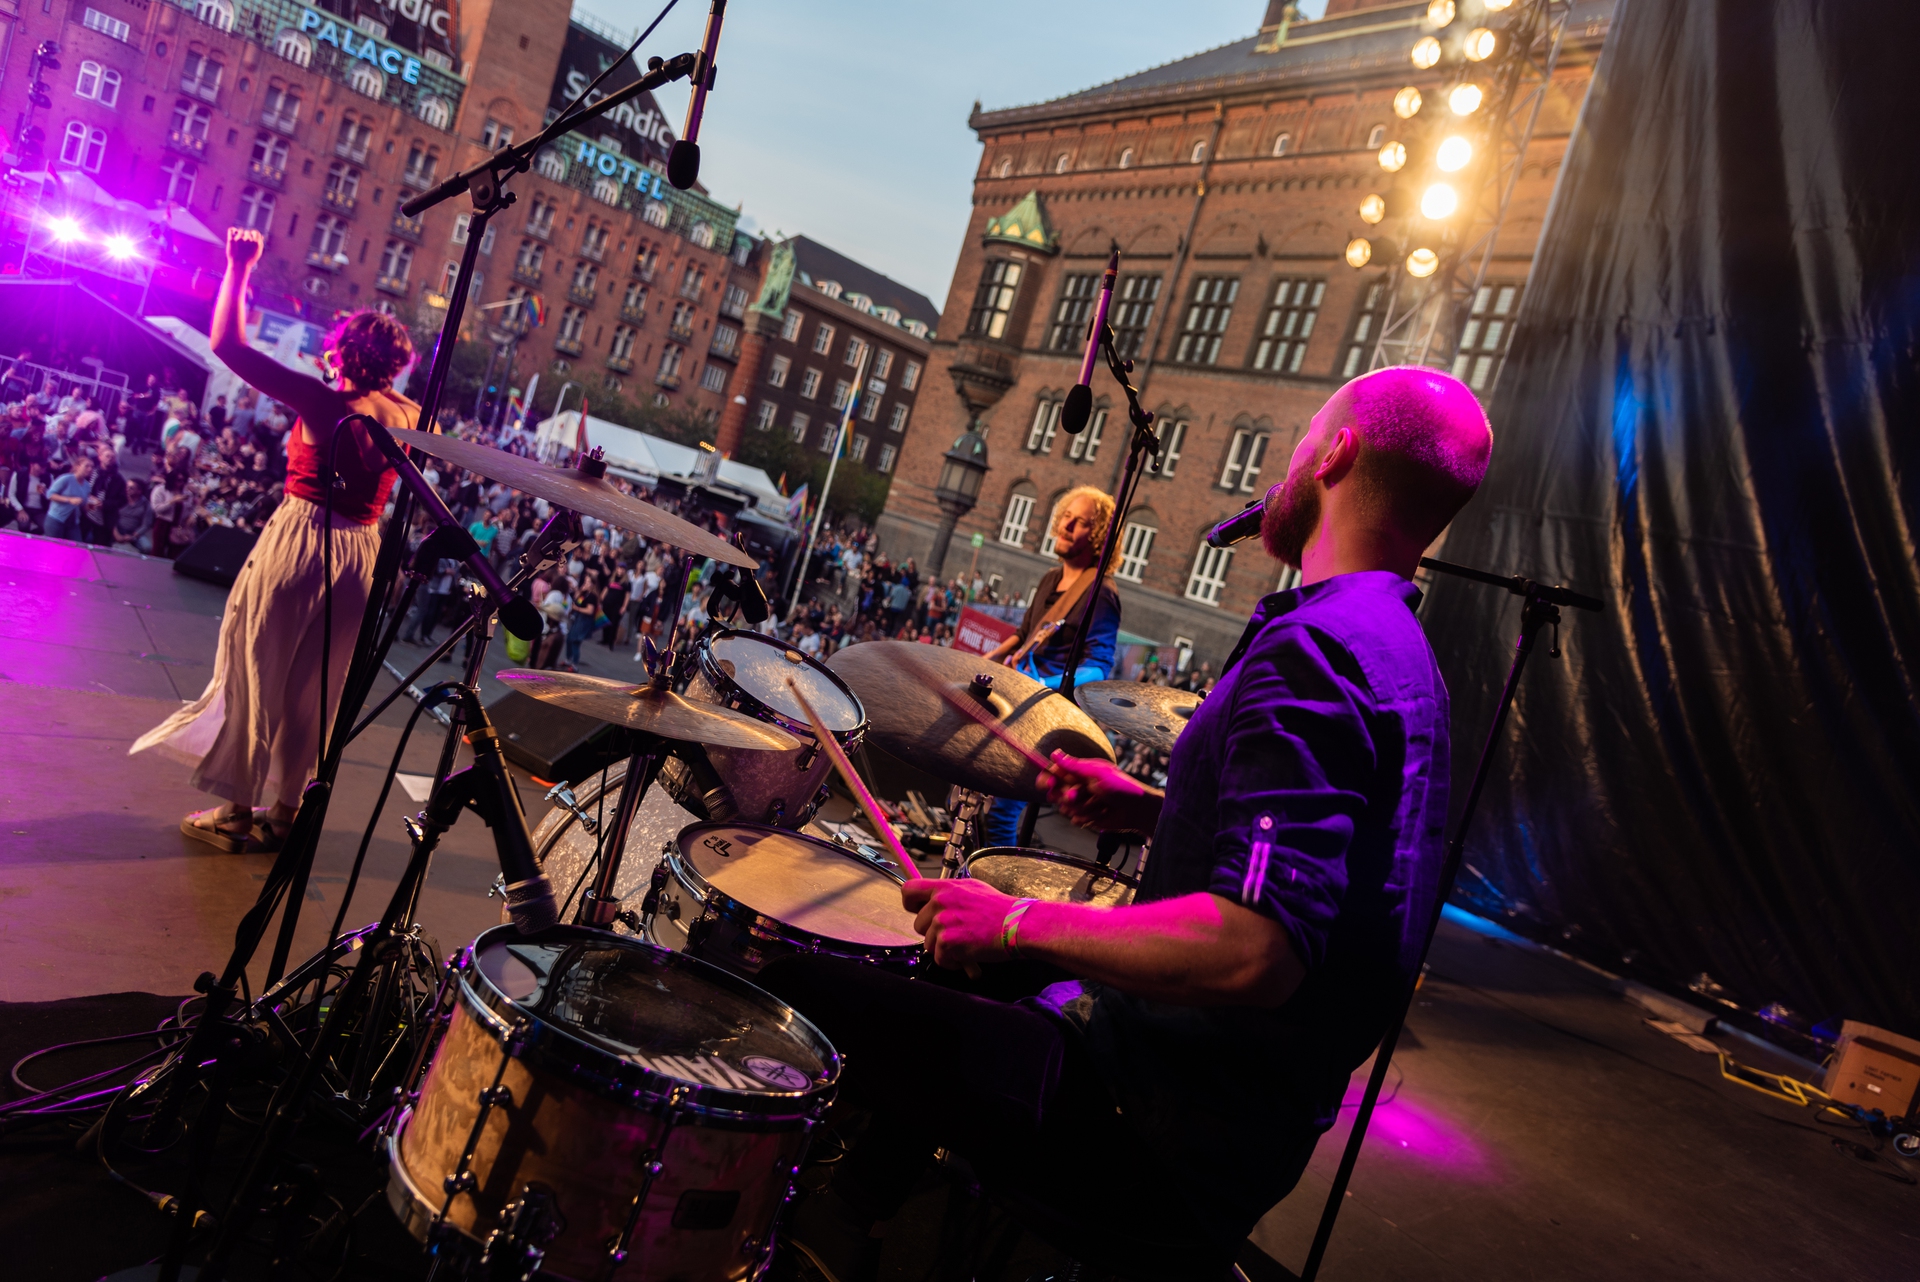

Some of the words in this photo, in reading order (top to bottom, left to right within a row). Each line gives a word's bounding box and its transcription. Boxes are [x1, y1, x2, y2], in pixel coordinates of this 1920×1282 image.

[301, 7, 421, 85] PALACE
[577, 141, 663, 200] HOTEL
[617, 1054, 766, 1090] YAM
